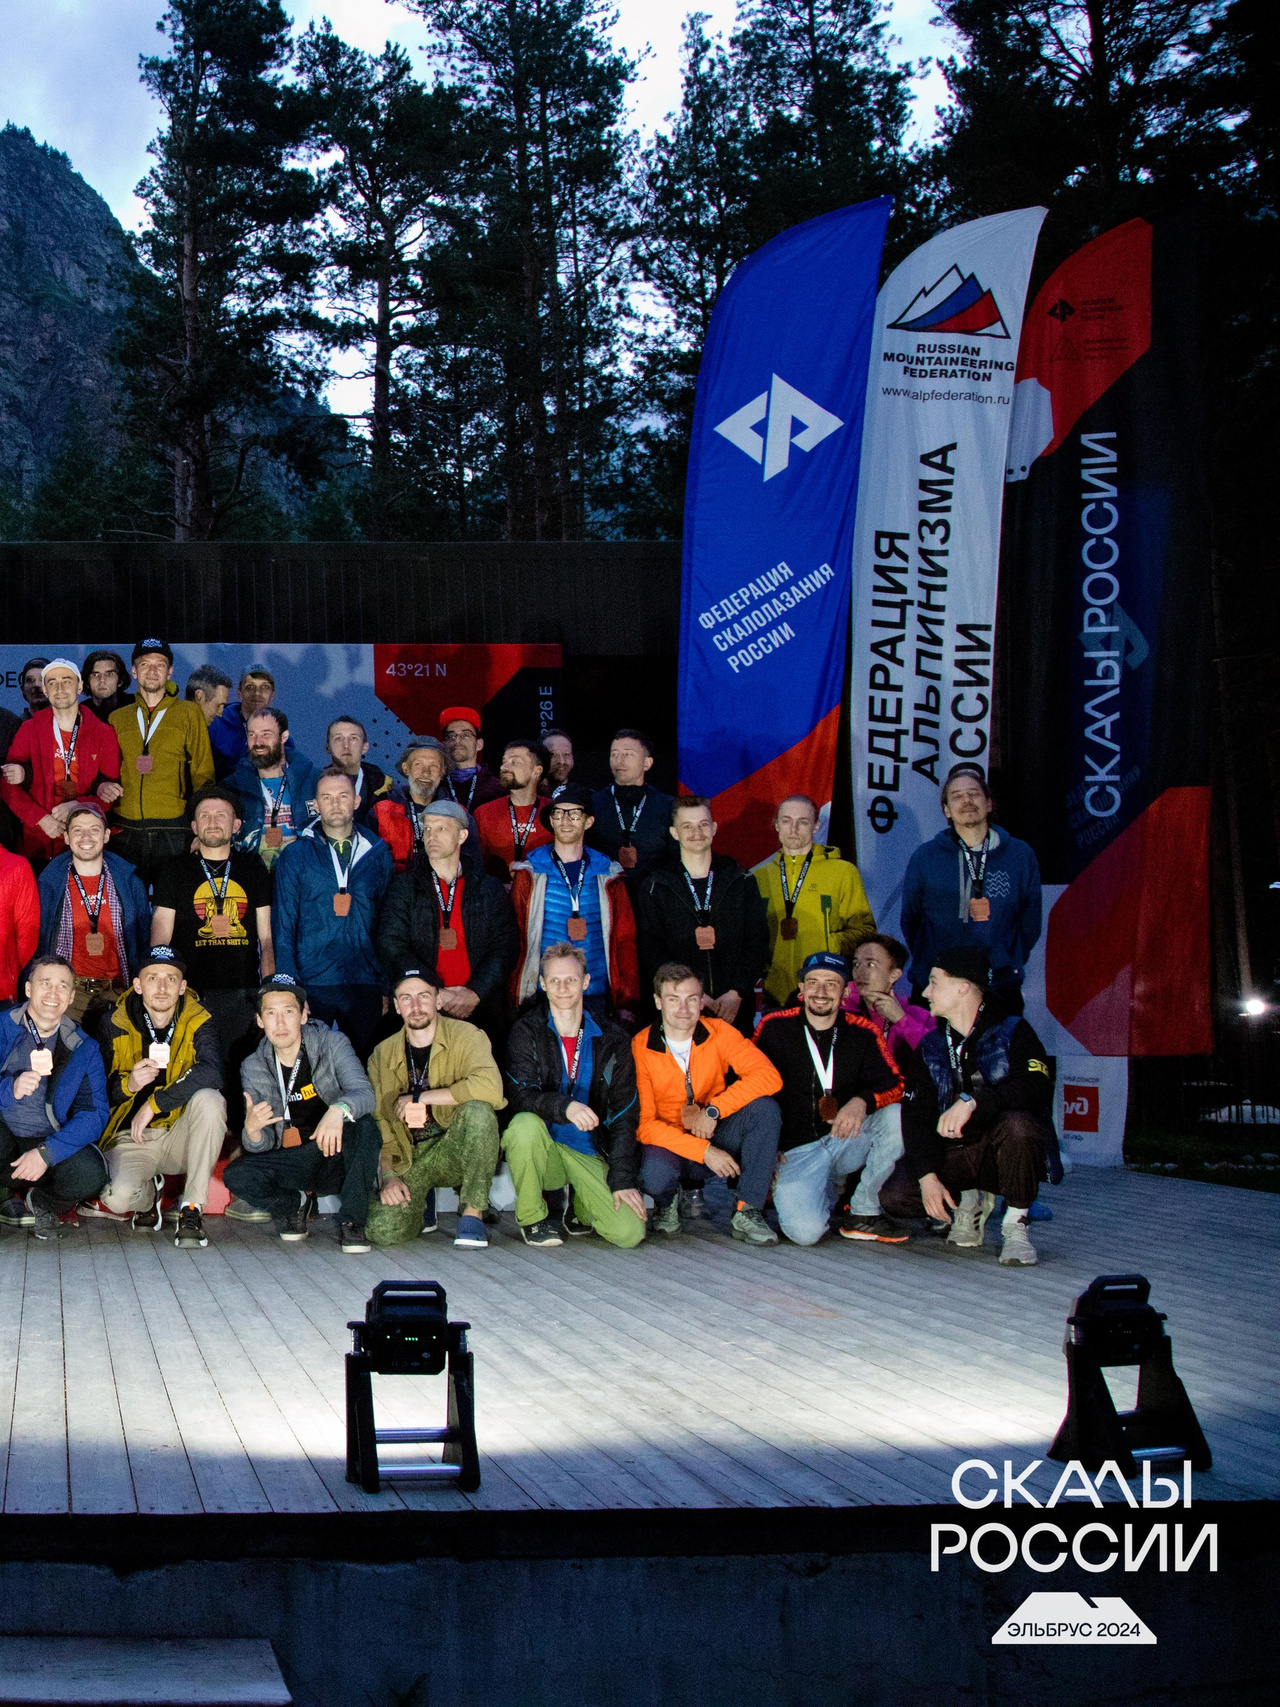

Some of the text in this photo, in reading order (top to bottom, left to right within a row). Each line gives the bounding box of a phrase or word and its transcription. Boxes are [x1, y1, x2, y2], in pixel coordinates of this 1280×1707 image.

[916, 343, 981, 357] RUSSIAN
[883, 352, 1015, 372] MOUNTAINEERING
[903, 366, 992, 382] FEDERATION
[882, 386, 1010, 406] www.alpfederation.ru
[698, 561, 795, 631] ФЕДЕРАЦИЯ
[711, 563, 836, 653] СКАЛОЛАЗАНИЯ
[912, 441, 958, 786] АЛЬПИНИЗМА
[1080, 431, 1121, 818] СКАЛЫ РОССИИ
[727, 622, 797, 674] РОССИИ
[385, 663, 447, 677] 43°21 N
[539, 685, 553, 696] E
[866, 530, 914, 834] ФЕДЕРАЦИЯ
[195, 939, 207, 947] LET
[226, 938, 241, 946] SHIT
[241, 938, 249, 946] GO
